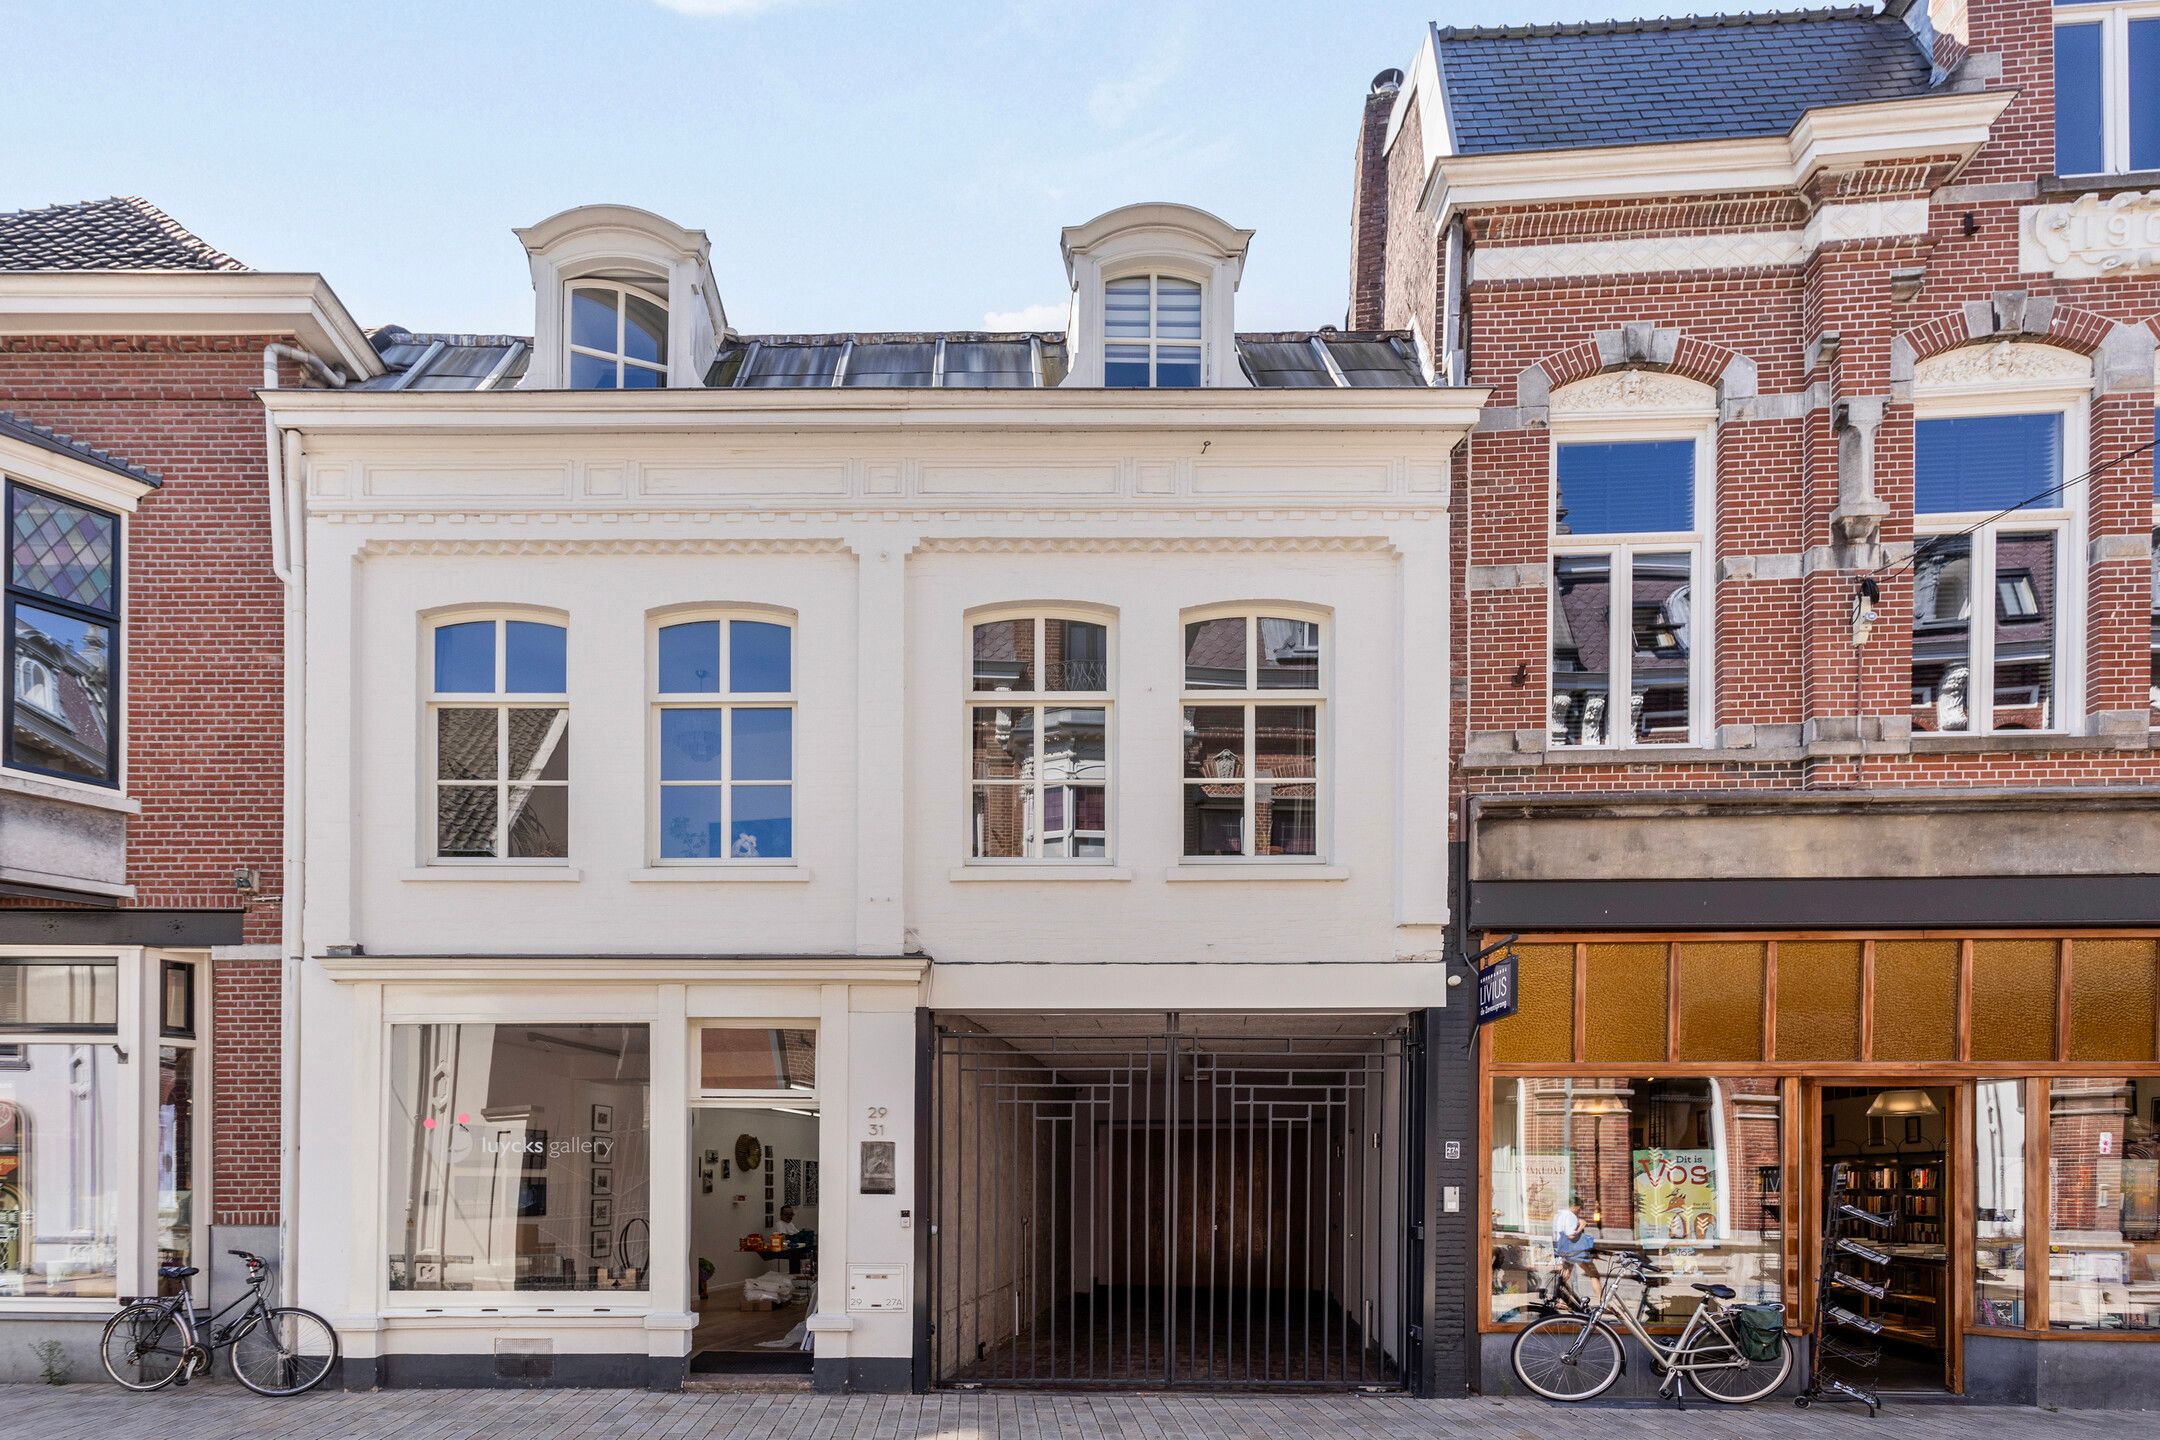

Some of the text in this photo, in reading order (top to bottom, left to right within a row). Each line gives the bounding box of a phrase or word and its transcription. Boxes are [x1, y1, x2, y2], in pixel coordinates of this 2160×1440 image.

[1480, 976, 1507, 1006] LIVIUS
[868, 1106, 888, 1119] 29
[868, 1124, 884, 1136] 31
[482, 1136, 614, 1158] luycks gallery
[1676, 1155, 1703, 1164] Dit is
[1638, 1157, 1709, 1187] Vos
[851, 1298, 903, 1306] 29 27A
